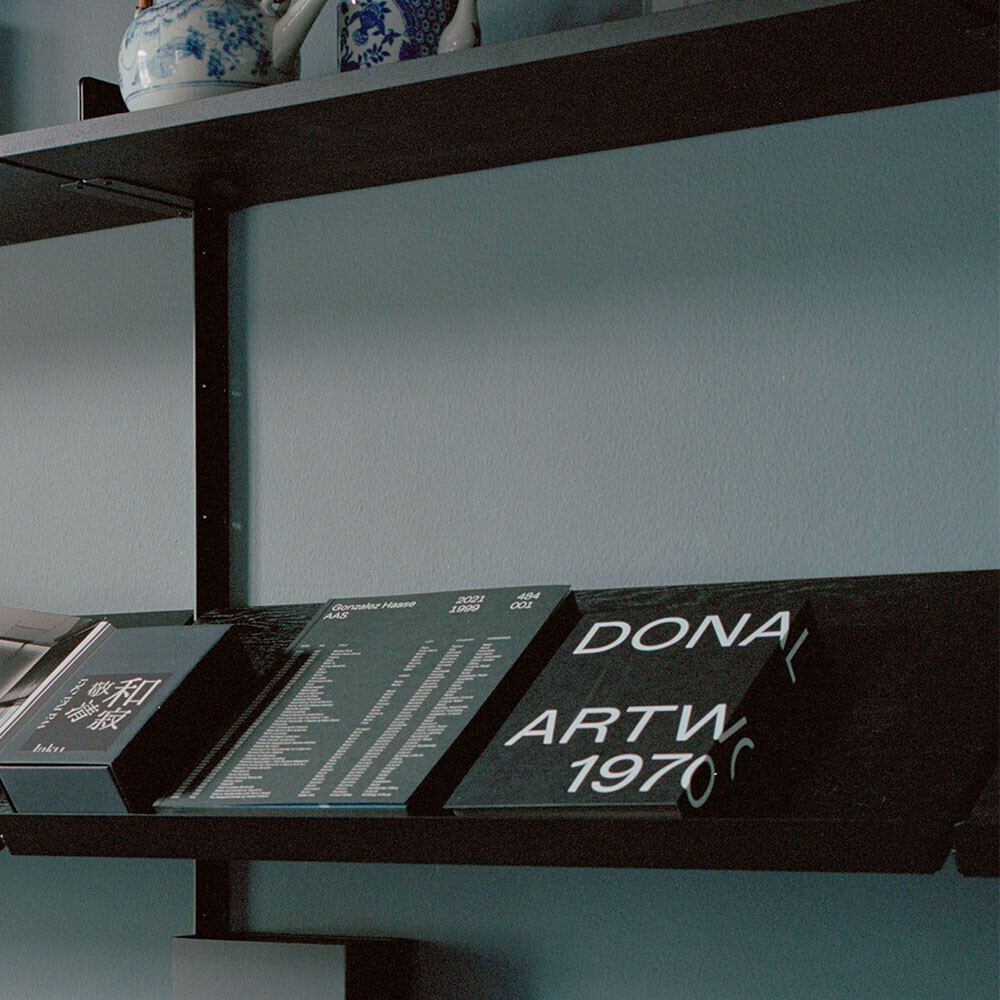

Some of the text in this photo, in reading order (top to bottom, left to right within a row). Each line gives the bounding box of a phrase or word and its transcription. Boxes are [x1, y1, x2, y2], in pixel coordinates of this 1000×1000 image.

[455, 595, 486, 604] 2021
[517, 592, 541, 600] 484
[332, 600, 417, 612] Gonzalez Haase
[449, 604, 481, 613] 1999
[510, 601, 533, 610] 001
[323, 611, 349, 620] AAS
[567, 753, 715, 808] 1970
